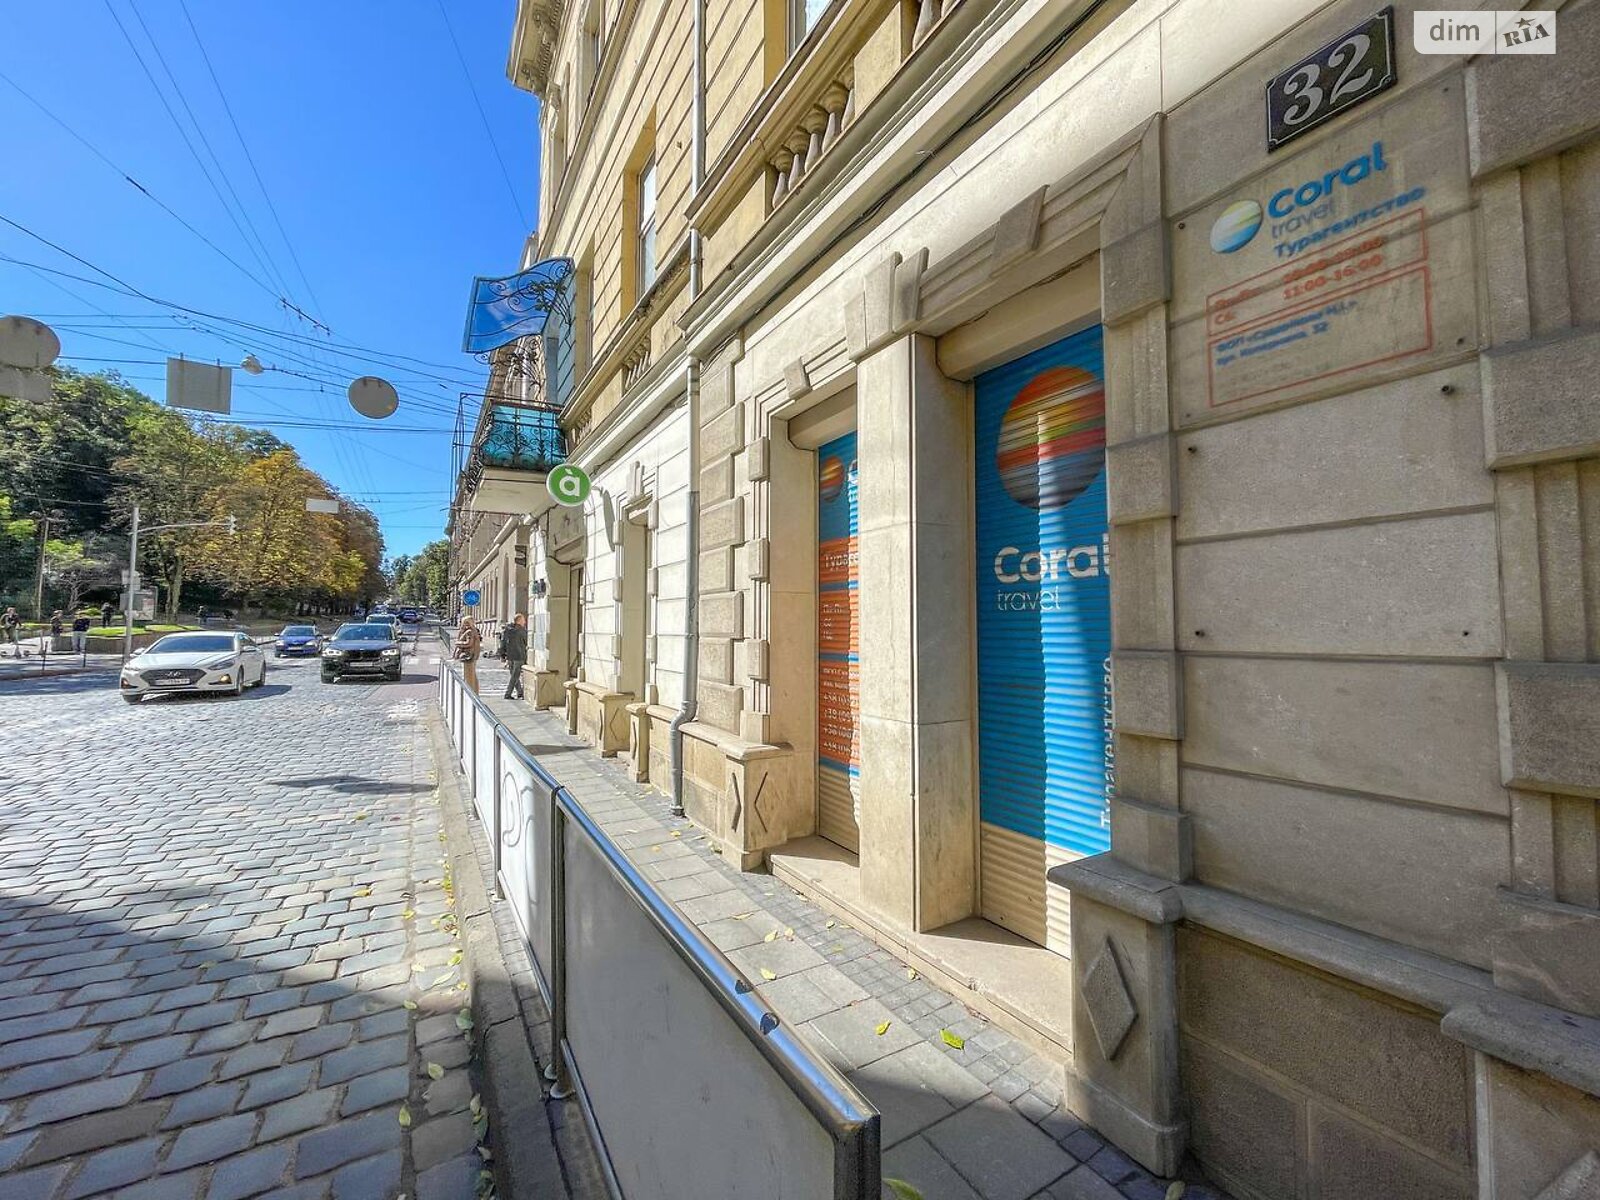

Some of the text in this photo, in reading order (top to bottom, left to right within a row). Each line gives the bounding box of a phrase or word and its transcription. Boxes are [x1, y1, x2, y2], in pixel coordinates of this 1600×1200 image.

[1283, 34, 1373, 125] 32
[1267, 141, 1388, 218] Coral
[1271, 199, 1336, 239] travel
[997, 586, 1061, 612] travel
